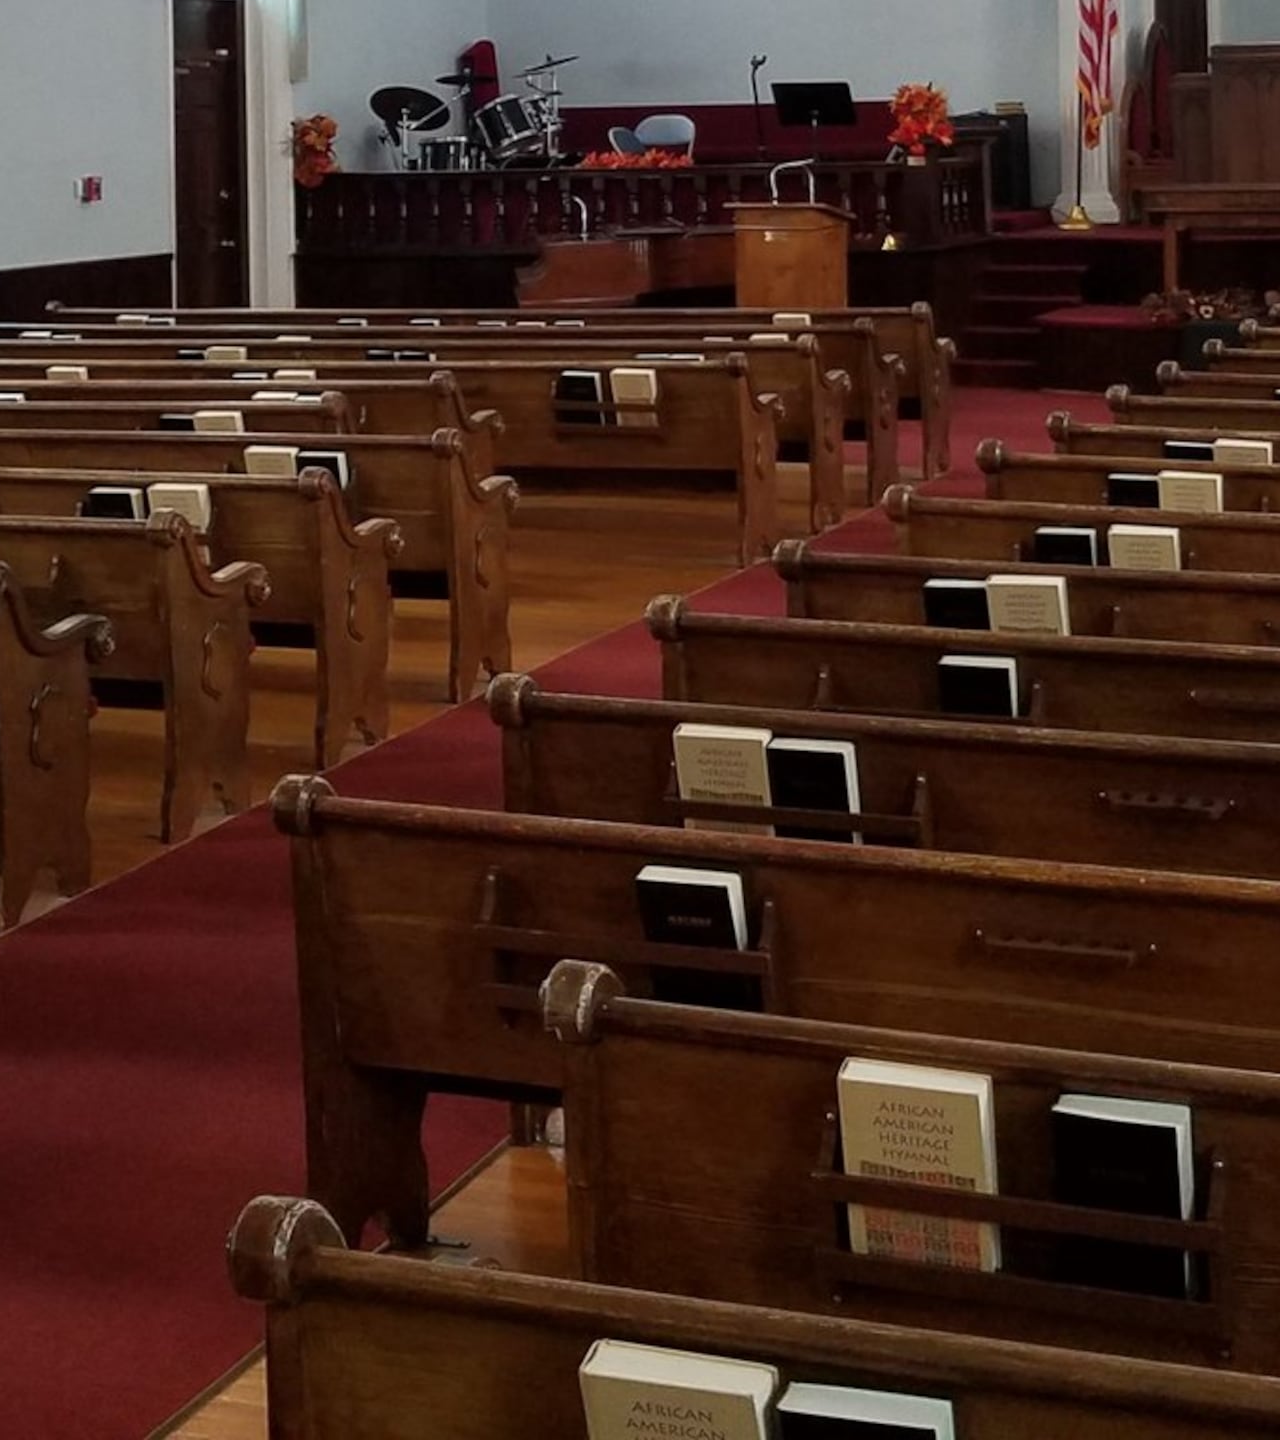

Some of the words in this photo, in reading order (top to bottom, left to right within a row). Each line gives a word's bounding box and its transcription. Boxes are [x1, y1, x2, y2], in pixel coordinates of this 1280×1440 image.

[879, 1101, 945, 1119] AFRICAN
[872, 1116, 954, 1135] AMERICAN
[879, 1131, 950, 1151] HERITAGE
[881, 1146, 949, 1167] HYMNAL
[631, 1401, 712, 1423] AFRICAN
[626, 1417, 726, 1440] AMERICAN
